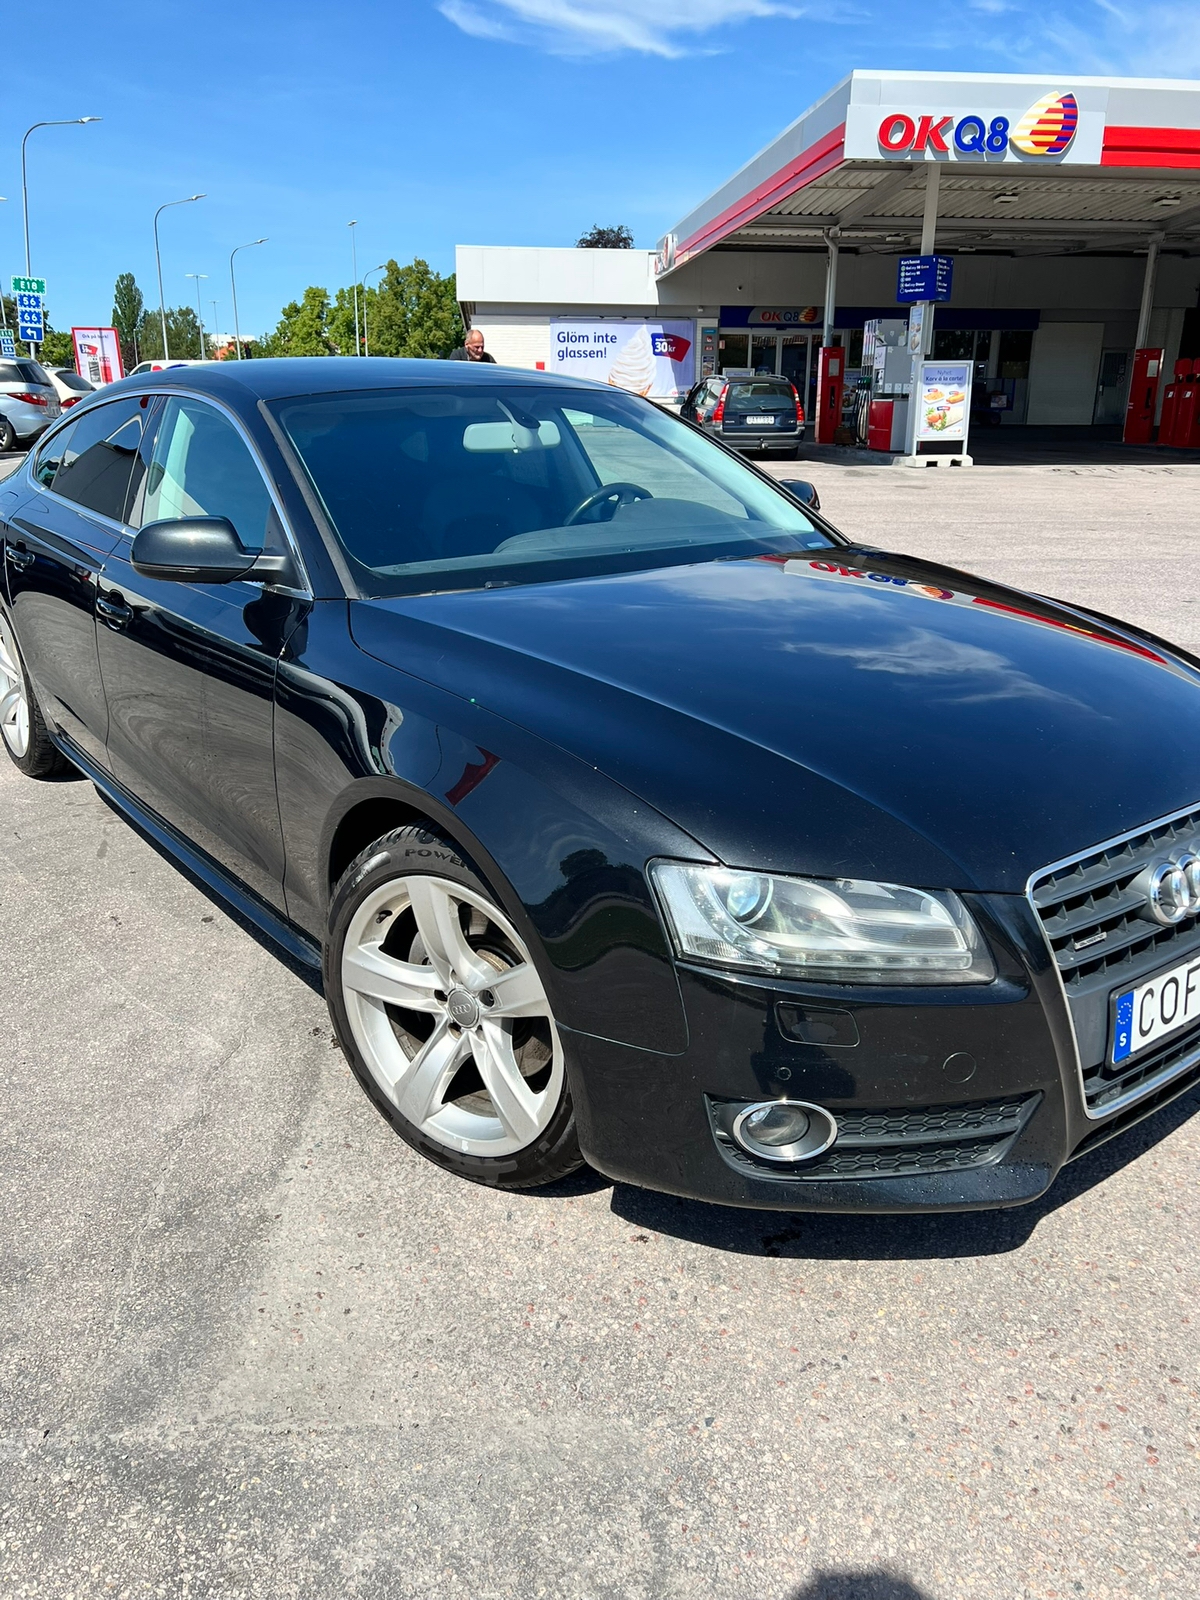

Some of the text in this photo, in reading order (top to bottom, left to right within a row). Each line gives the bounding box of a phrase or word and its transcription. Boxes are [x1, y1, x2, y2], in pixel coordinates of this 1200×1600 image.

[878, 113, 1010, 153] OKQ8
[20, 281, 37, 290] E18
[22, 297, 36, 306] 56
[24, 313, 37, 321] 66
[557, 331, 617, 343] Glöm inte
[655, 342, 667, 352] 30
[558, 346, 606, 361] glassen!
[1120, 1032, 1127, 1048] S
